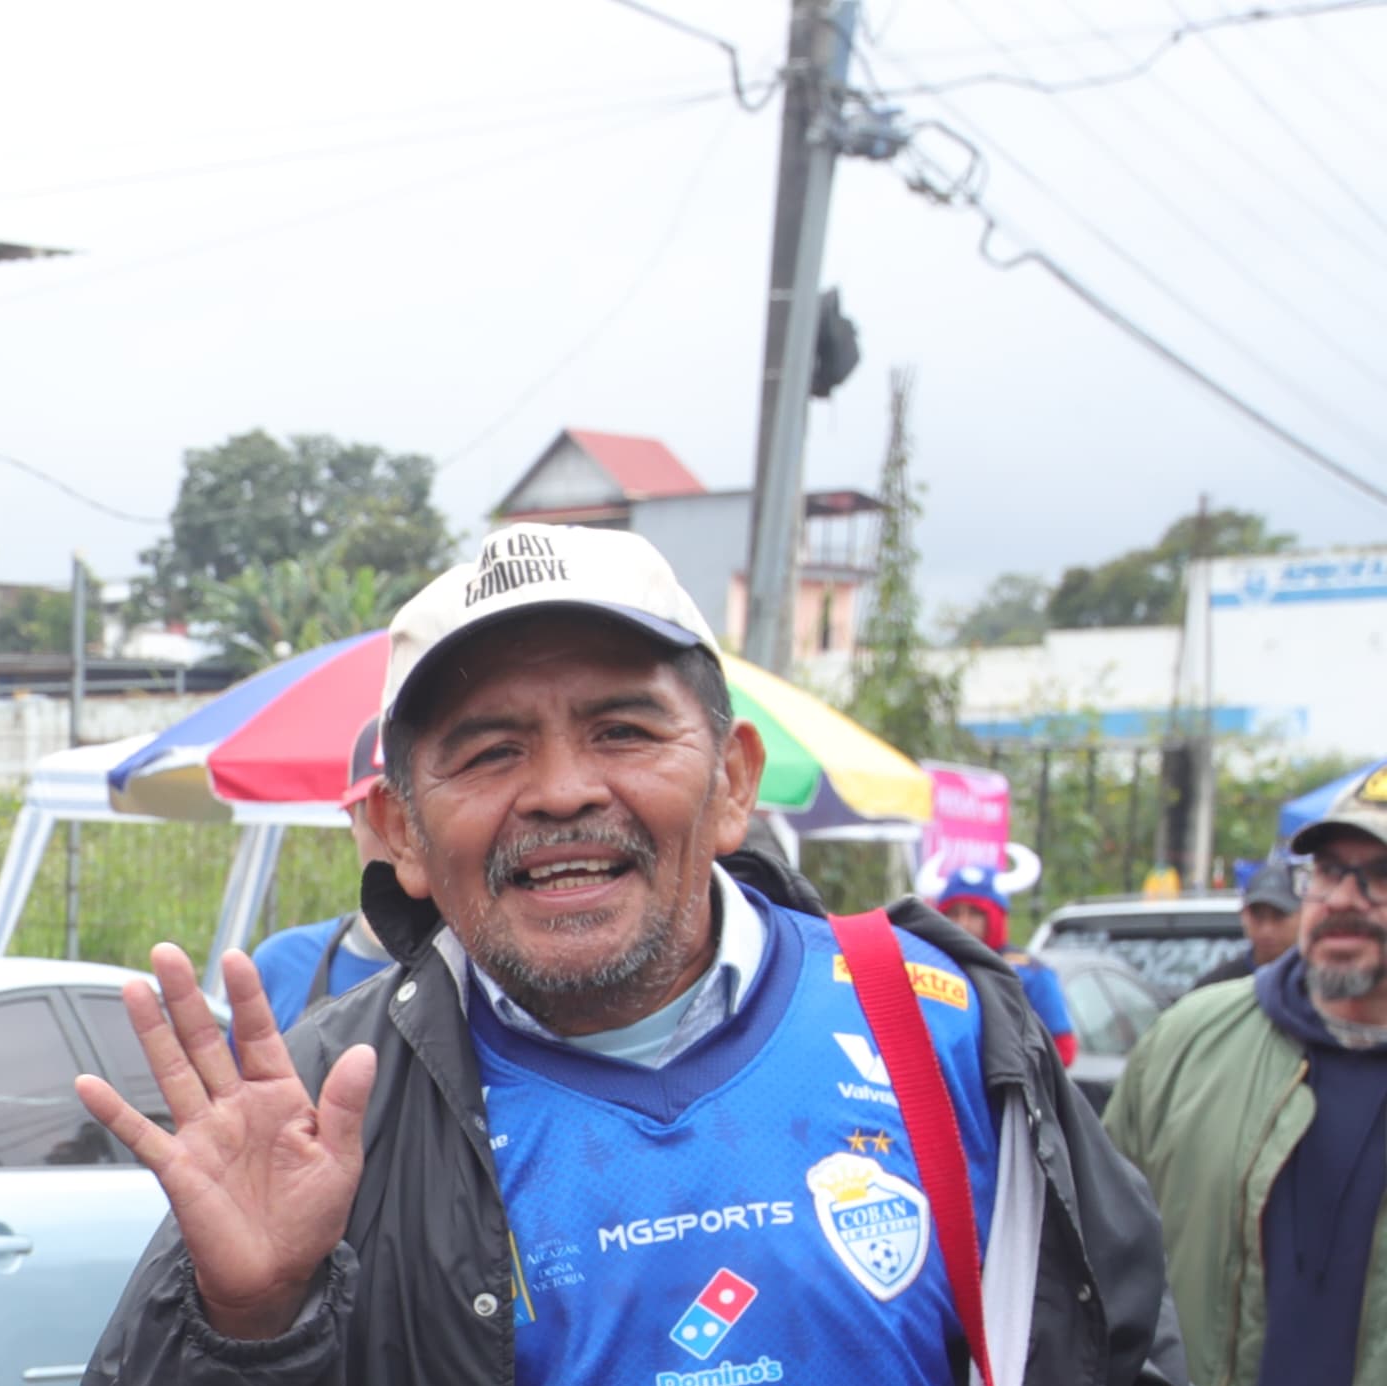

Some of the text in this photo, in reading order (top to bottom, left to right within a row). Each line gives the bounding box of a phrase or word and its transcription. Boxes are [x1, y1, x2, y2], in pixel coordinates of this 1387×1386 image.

[479, 533, 556, 574] HE LAST
[837, 1081, 902, 1109] Valvo
[598, 1201, 795, 1253] MGSPORTS
